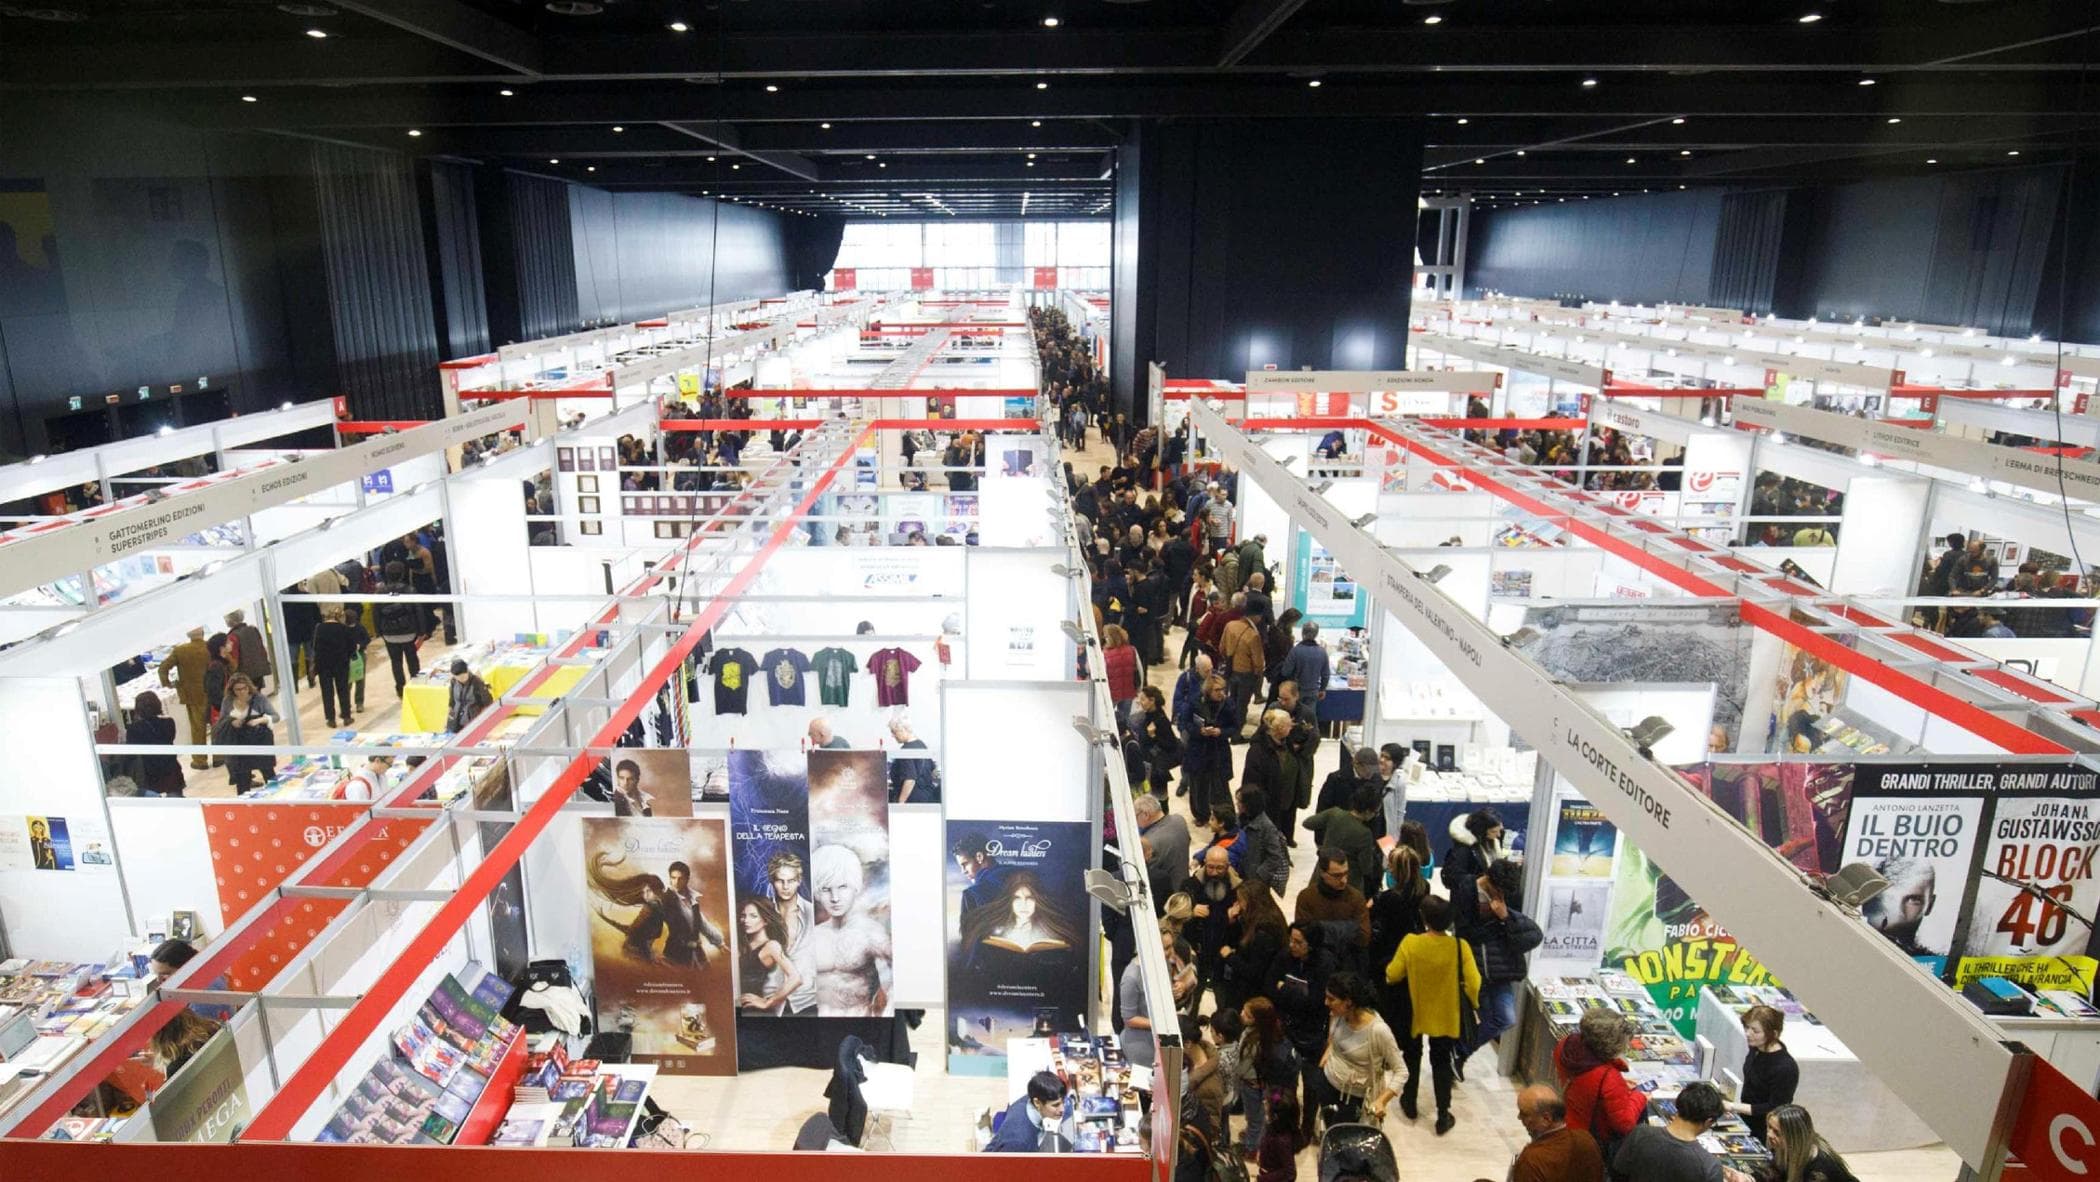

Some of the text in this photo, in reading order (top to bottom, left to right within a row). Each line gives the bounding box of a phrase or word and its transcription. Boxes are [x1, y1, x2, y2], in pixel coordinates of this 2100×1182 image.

[1613, 412, 1640, 429] castoro
[109, 503, 206, 541] GATTOMERLINO EDIZIONI
[111, 526, 169, 554] SUPERSTRIPES
[1459, 638, 1482, 667] NAPOLI
[1567, 727, 1672, 830] LA CORTE EDITORE
[1880, 773, 2098, 791] GRANDI THRILLER, GRANDI AUTORI
[1872, 804, 1960, 812] ANTONIO LANZETTA
[2032, 803, 2089, 820] JOHANA
[1861, 814, 1963, 836] IL BUIO
[736, 832, 805, 841] DELLA TEMPESTA
[985, 839, 1019, 857] Dream
[1856, 838, 1959, 858] DENTRO
[1996, 843, 2100, 882] BLOCK
[1996, 883, 2074, 947] 46
[1544, 934, 1598, 945] LA CITTÀ
[1664, 923, 1700, 938] FABIO
[1963, 963, 1972, 974] IL
[1974, 962, 2017, 974] THRILLER
[2049, 1113, 2096, 1175] C
